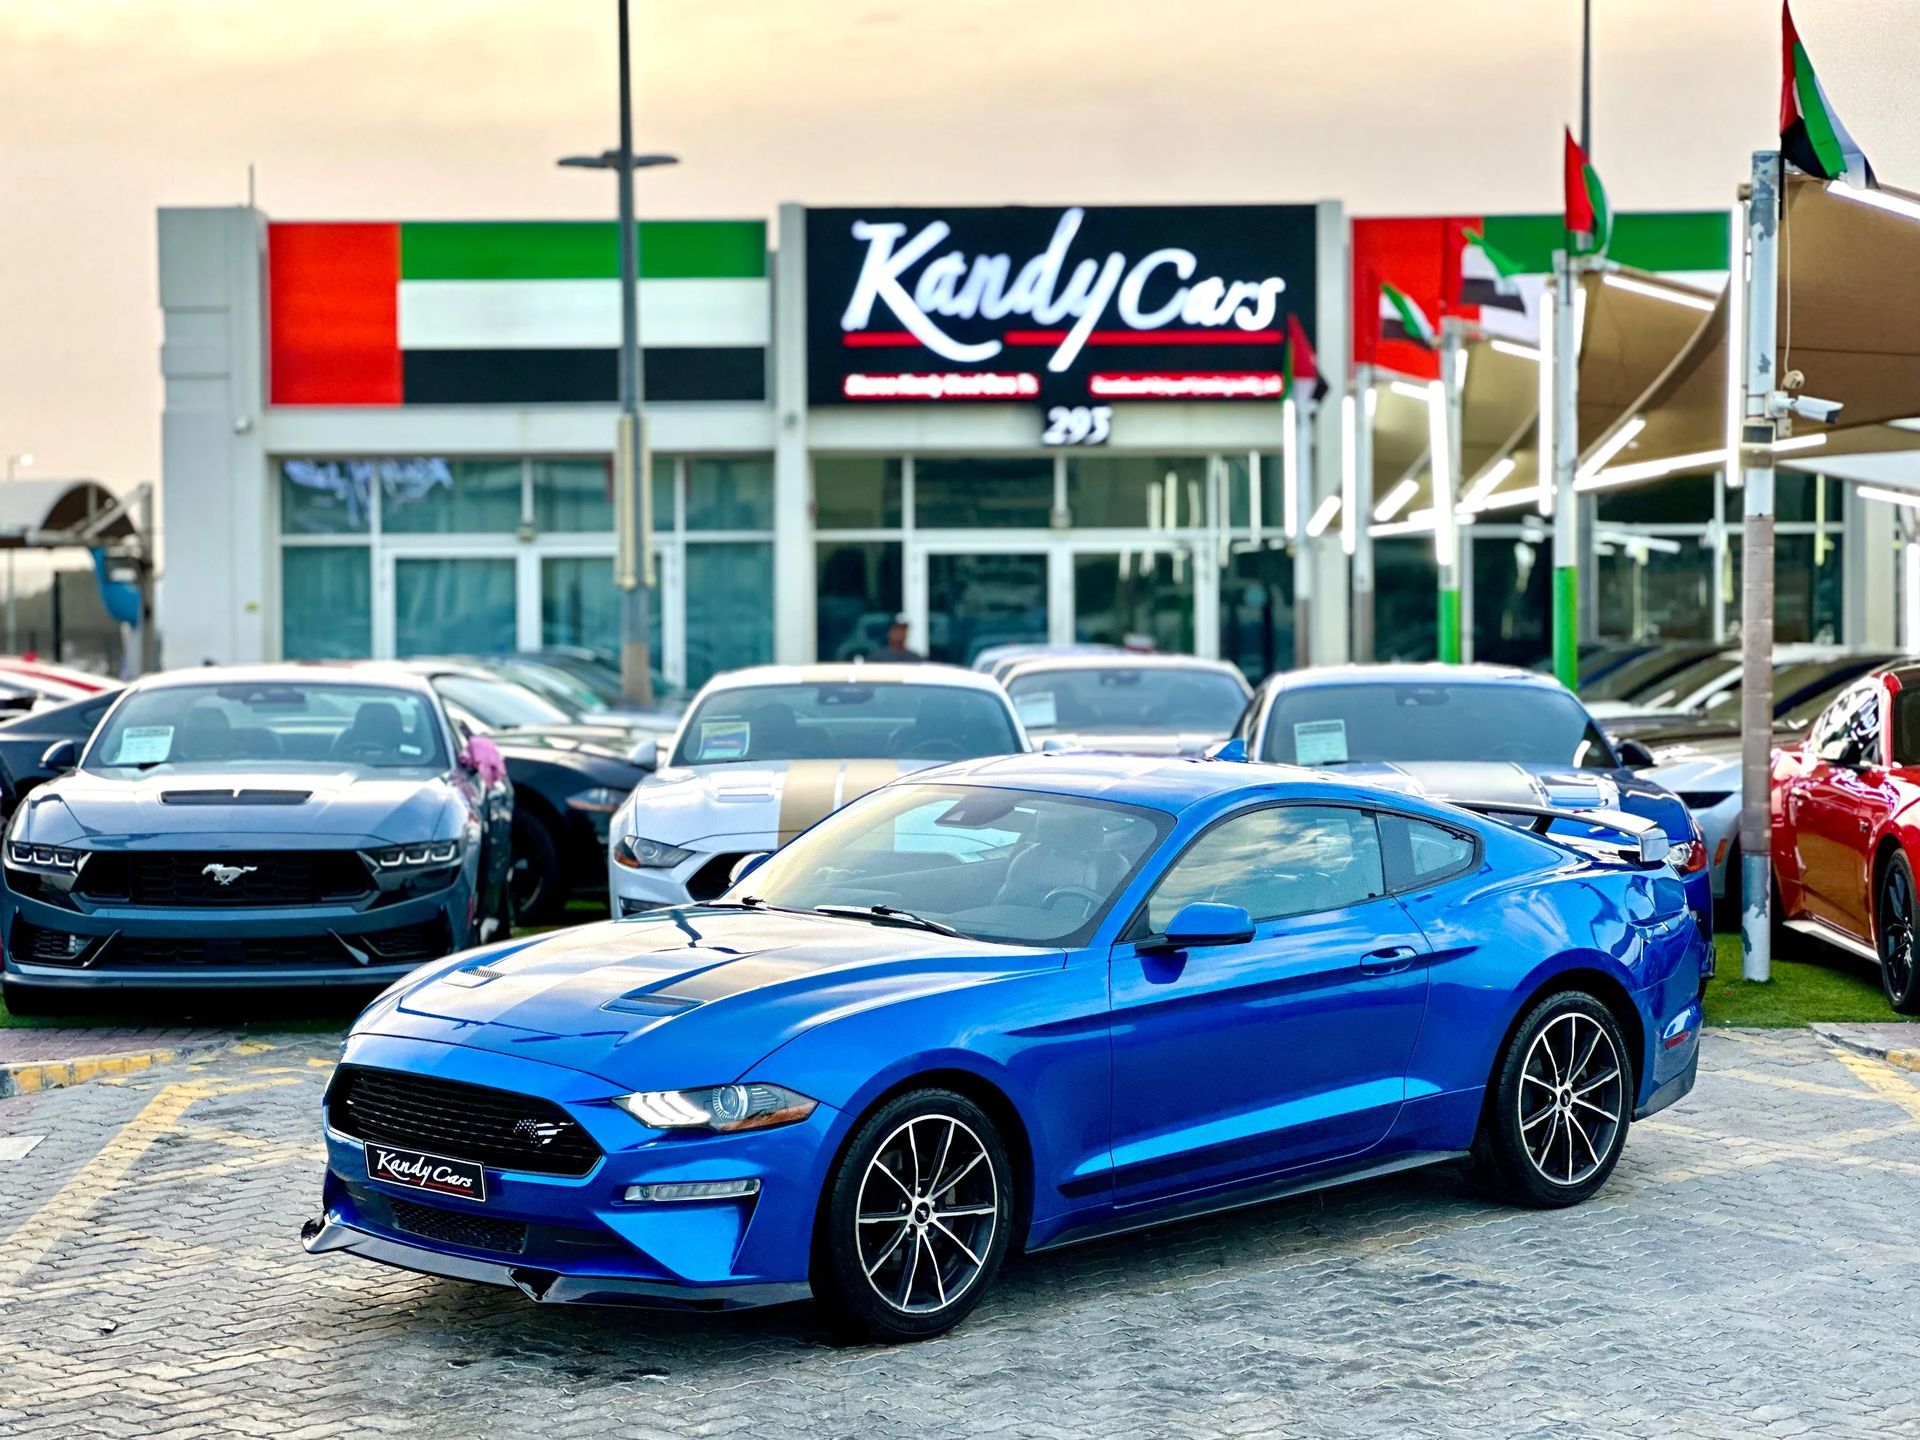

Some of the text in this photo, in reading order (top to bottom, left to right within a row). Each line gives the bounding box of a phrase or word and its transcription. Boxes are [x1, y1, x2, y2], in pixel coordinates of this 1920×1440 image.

[841, 207, 1286, 372] Kandy Cars
[1042, 405, 1113, 445] 295
[376, 1149, 473, 1188] Kandy Cars
